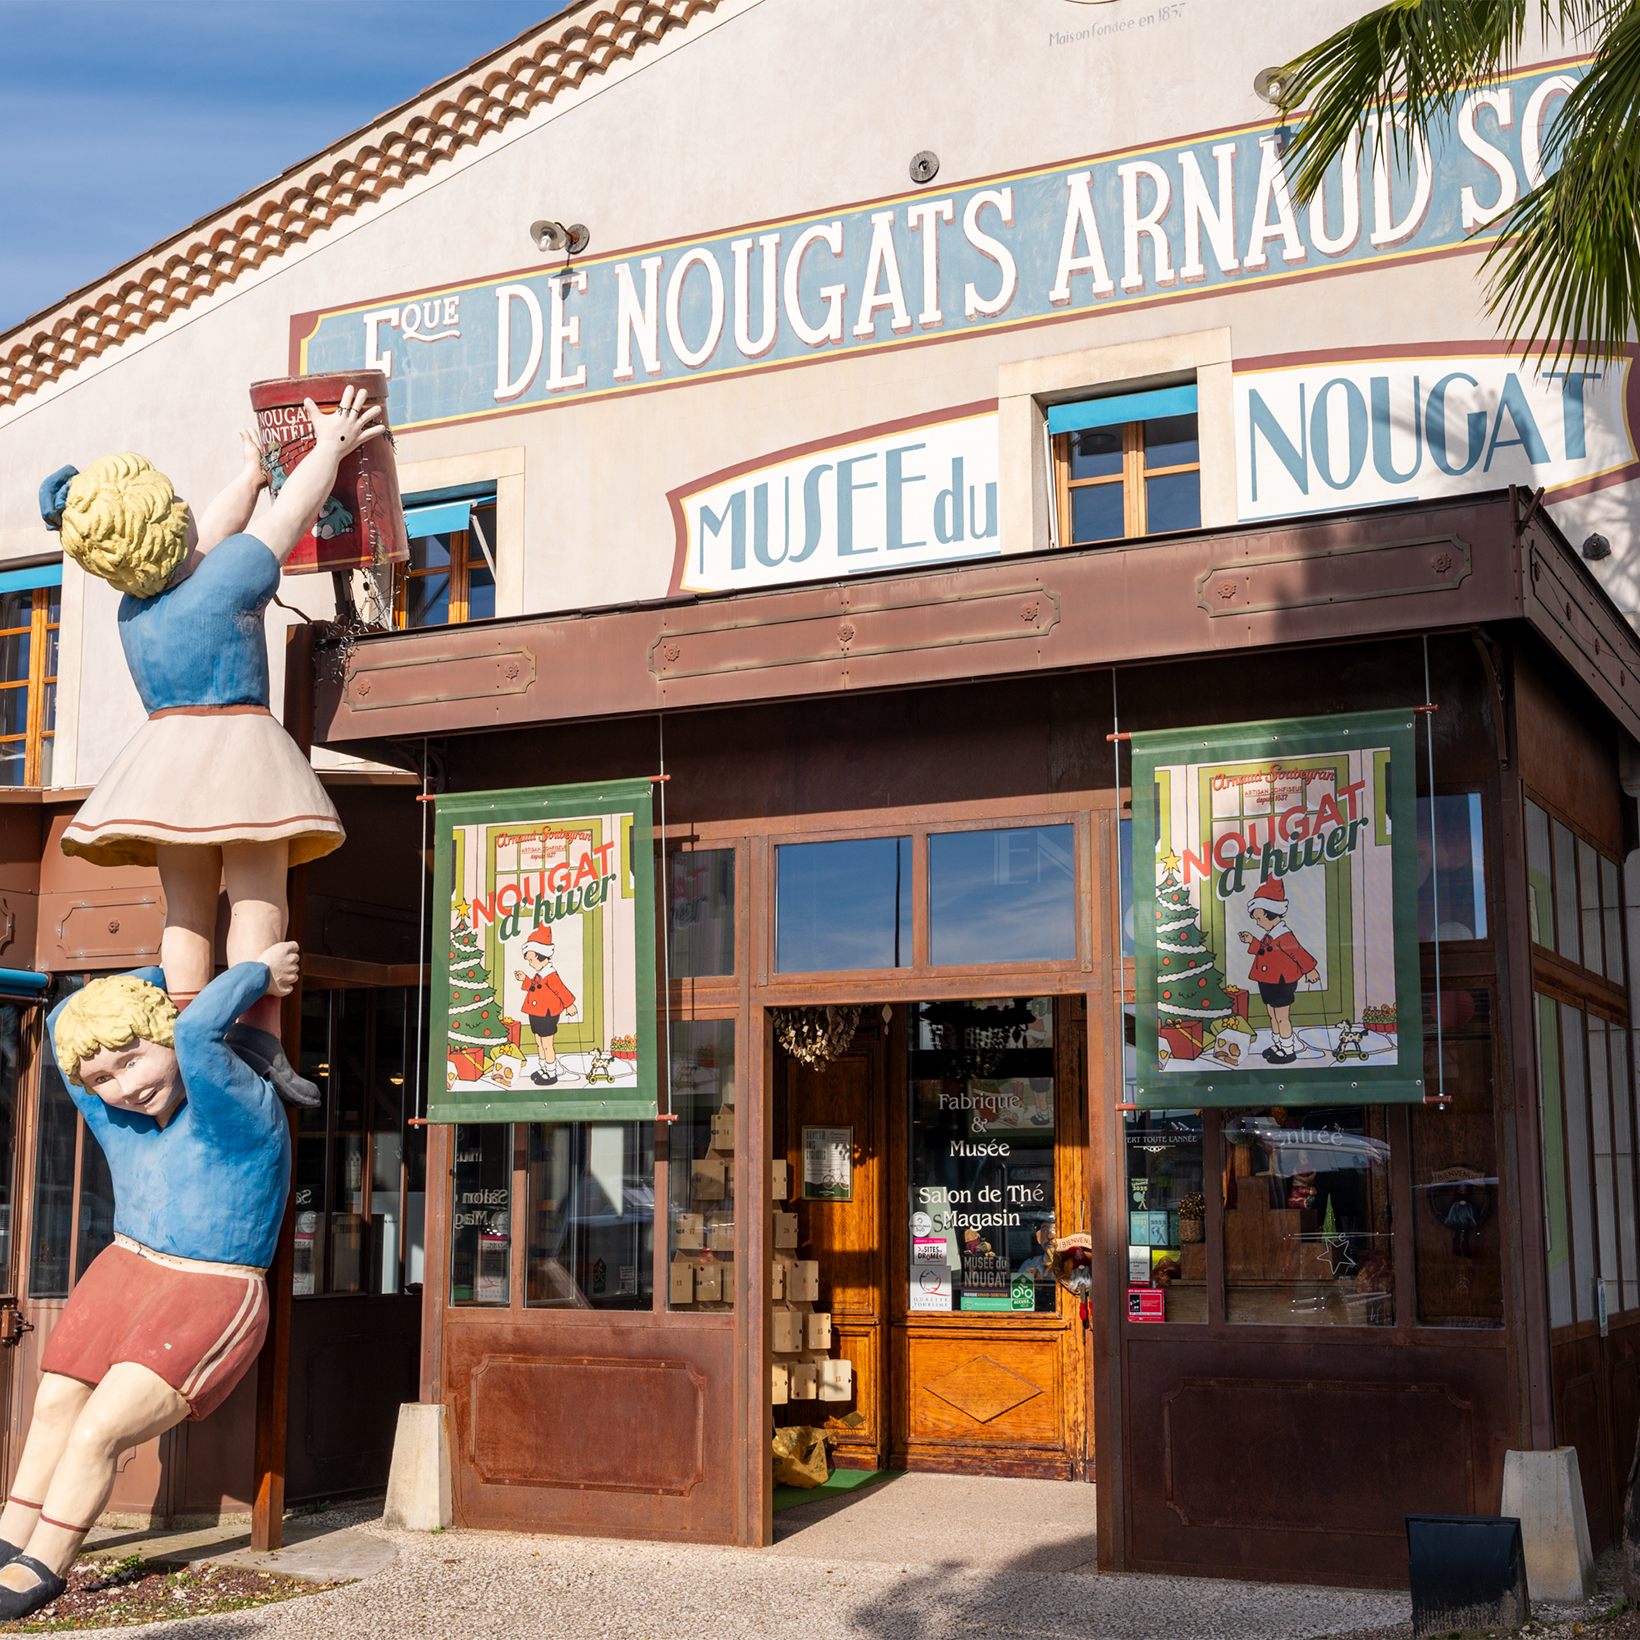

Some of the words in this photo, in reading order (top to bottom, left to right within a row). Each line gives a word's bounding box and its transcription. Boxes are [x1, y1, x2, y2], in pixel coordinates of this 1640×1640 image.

[1049, 28, 1090, 46] Maison
[1092, 18, 1135, 37] fondée
[1138, 14, 1155, 28] en
[493, 271, 588, 403] DE
[613, 186, 1018, 383] NOUGATS
[1049, 110, 1434, 309] ARNAUD
[1248, 371, 1602, 502] NOUGAT
[699, 442, 927, 575] MUSEE
[932, 456, 998, 544] du
[1244, 788, 1269, 796] ARTISAN
[1270, 785, 1303, 794] CONFISEUR
[1183, 780, 1366, 886] NOUGAT
[1217, 817, 1369, 897] d'hiver
[472, 841, 615, 931] NOUGAT
[499, 872, 617, 942] d'hiver
[939, 1092, 1021, 1113] Fabrique
[971, 1116, 988, 1133] &
[950, 1138, 1011, 1157] Musée
[919, 1187, 972, 1204] Salon
[978, 1185, 1002, 1203] de
[1007, 1184, 1045, 1202] Thé
[943, 1209, 1021, 1232] Magasin
[964, 1256, 994, 1270] MUSEE
[995, 1257, 1007, 1269] du
[964, 1271, 1008, 1287] NOUGAT
